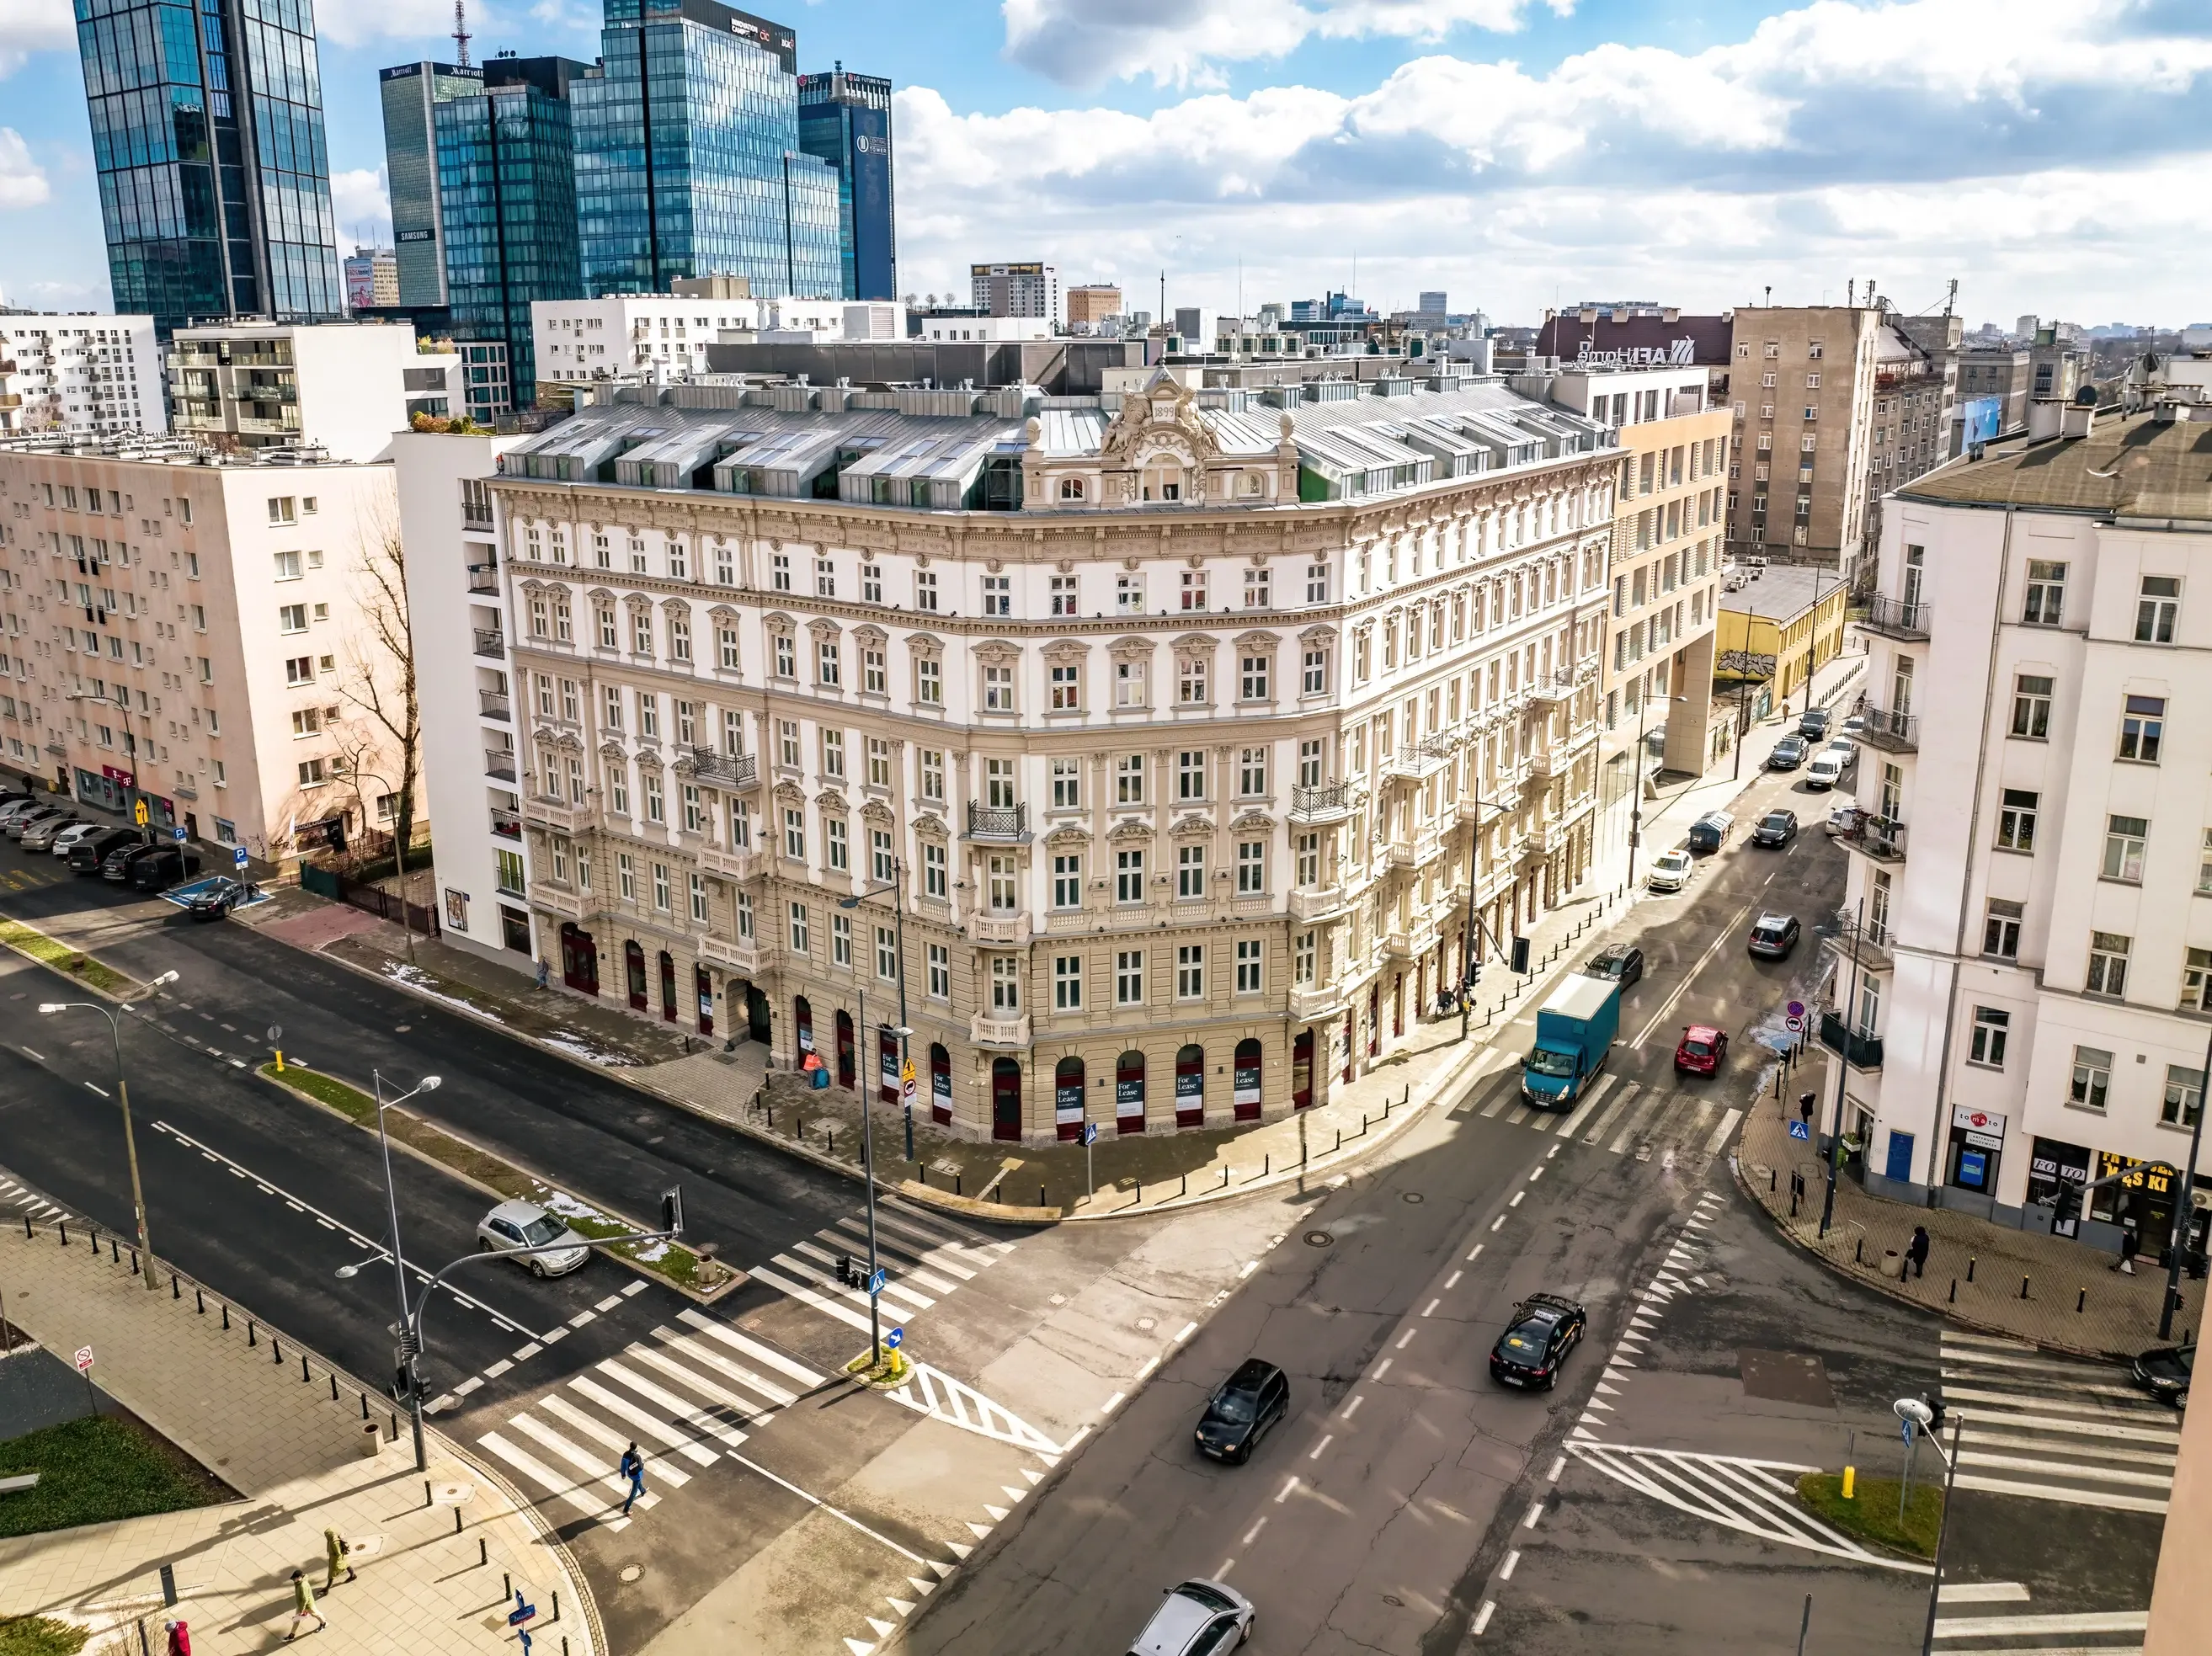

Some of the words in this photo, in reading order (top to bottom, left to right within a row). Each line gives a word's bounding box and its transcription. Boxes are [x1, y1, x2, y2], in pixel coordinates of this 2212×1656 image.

[391, 66, 412, 77] Marriott
[808, 74, 818, 83] LG
[870, 136, 887, 145] CENTRAL
[401, 231, 428, 241] SAMSUNG
[1154, 407, 1174, 418] 1899
[175, 828, 183, 839] P
[237, 849, 244, 859] P
[882, 1053, 892, 1062] For
[882, 1060, 898, 1070] Lease
[934, 1073, 943, 1082] For
[934, 1079, 949, 1090] Lease
[1960, 1112, 1997, 1126] tomato
